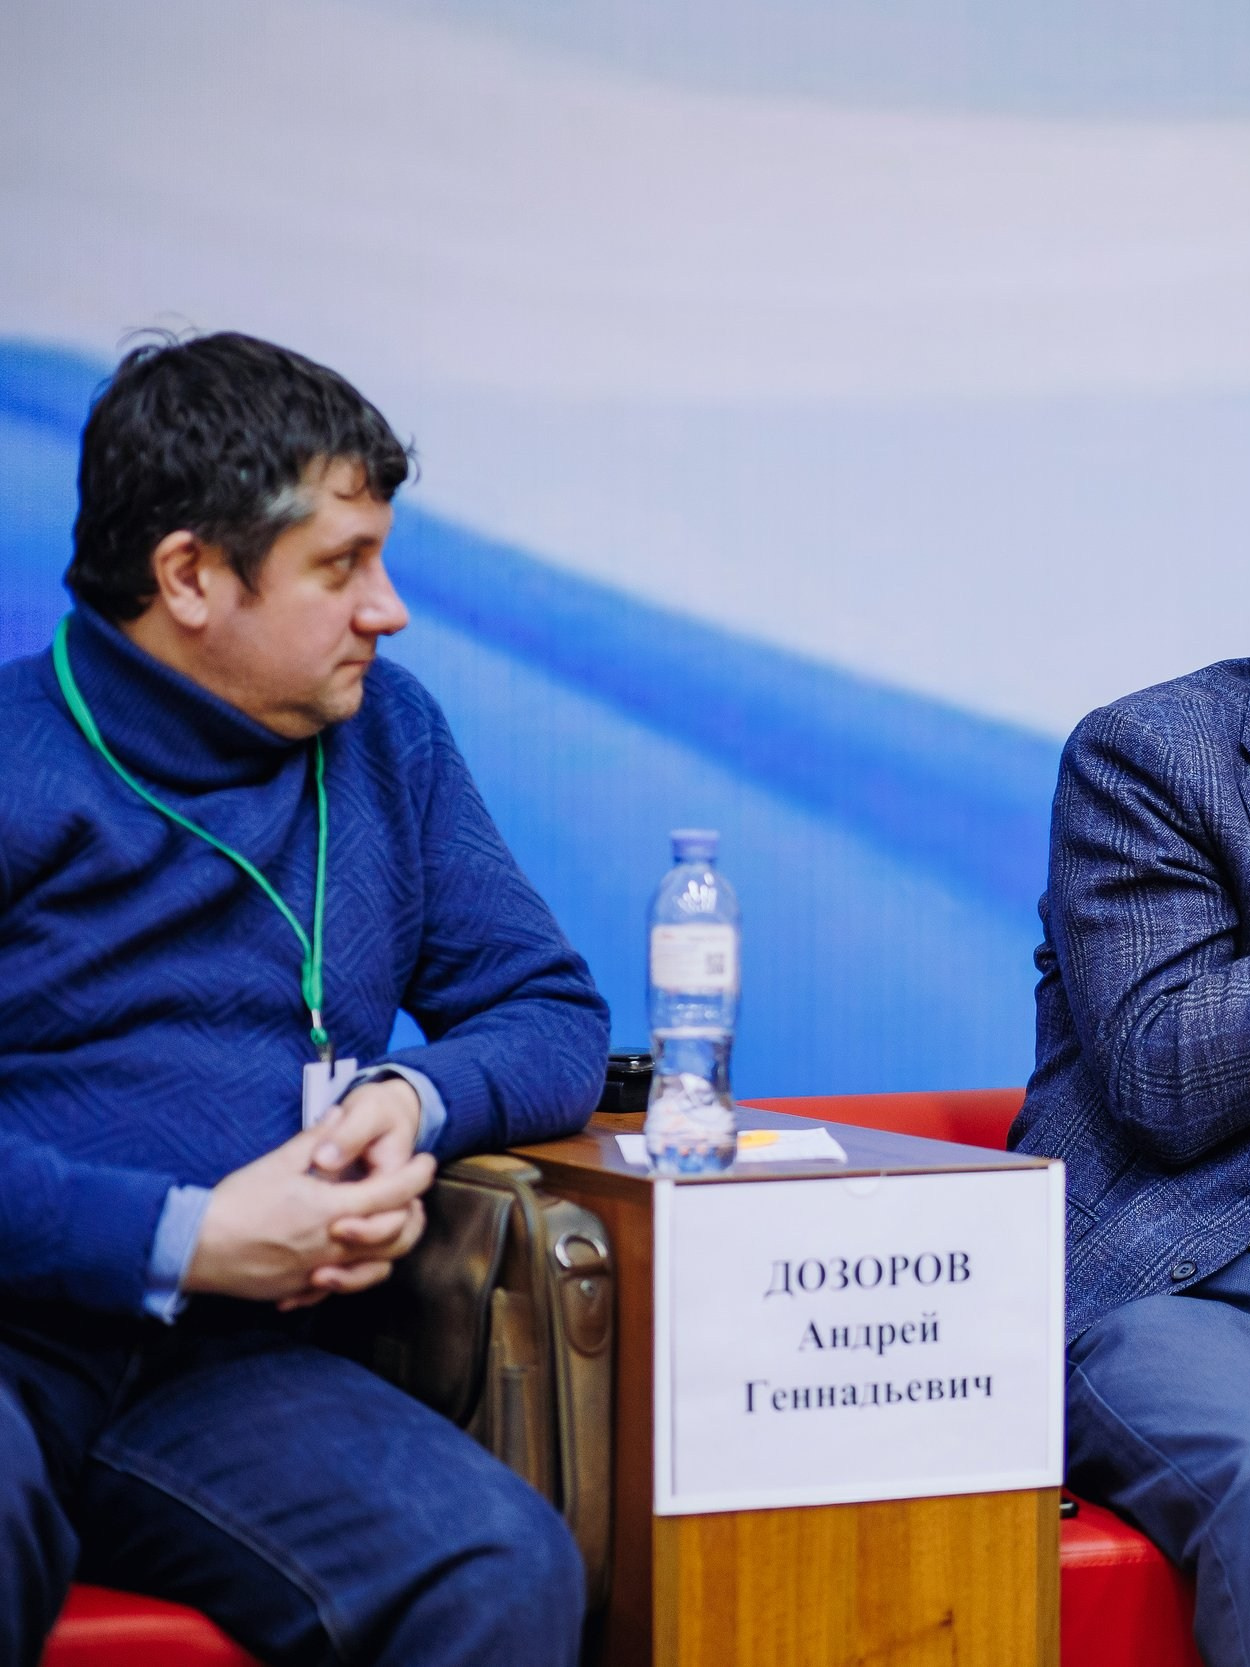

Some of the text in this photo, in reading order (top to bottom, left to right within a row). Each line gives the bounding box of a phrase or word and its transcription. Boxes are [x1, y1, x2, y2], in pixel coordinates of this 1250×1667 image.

[764, 1250, 971, 1300] ДОЗОРОВ
[798, 1311, 940, 1356] Андрей
[744, 1374, 993, 1414] Геннадьевич
